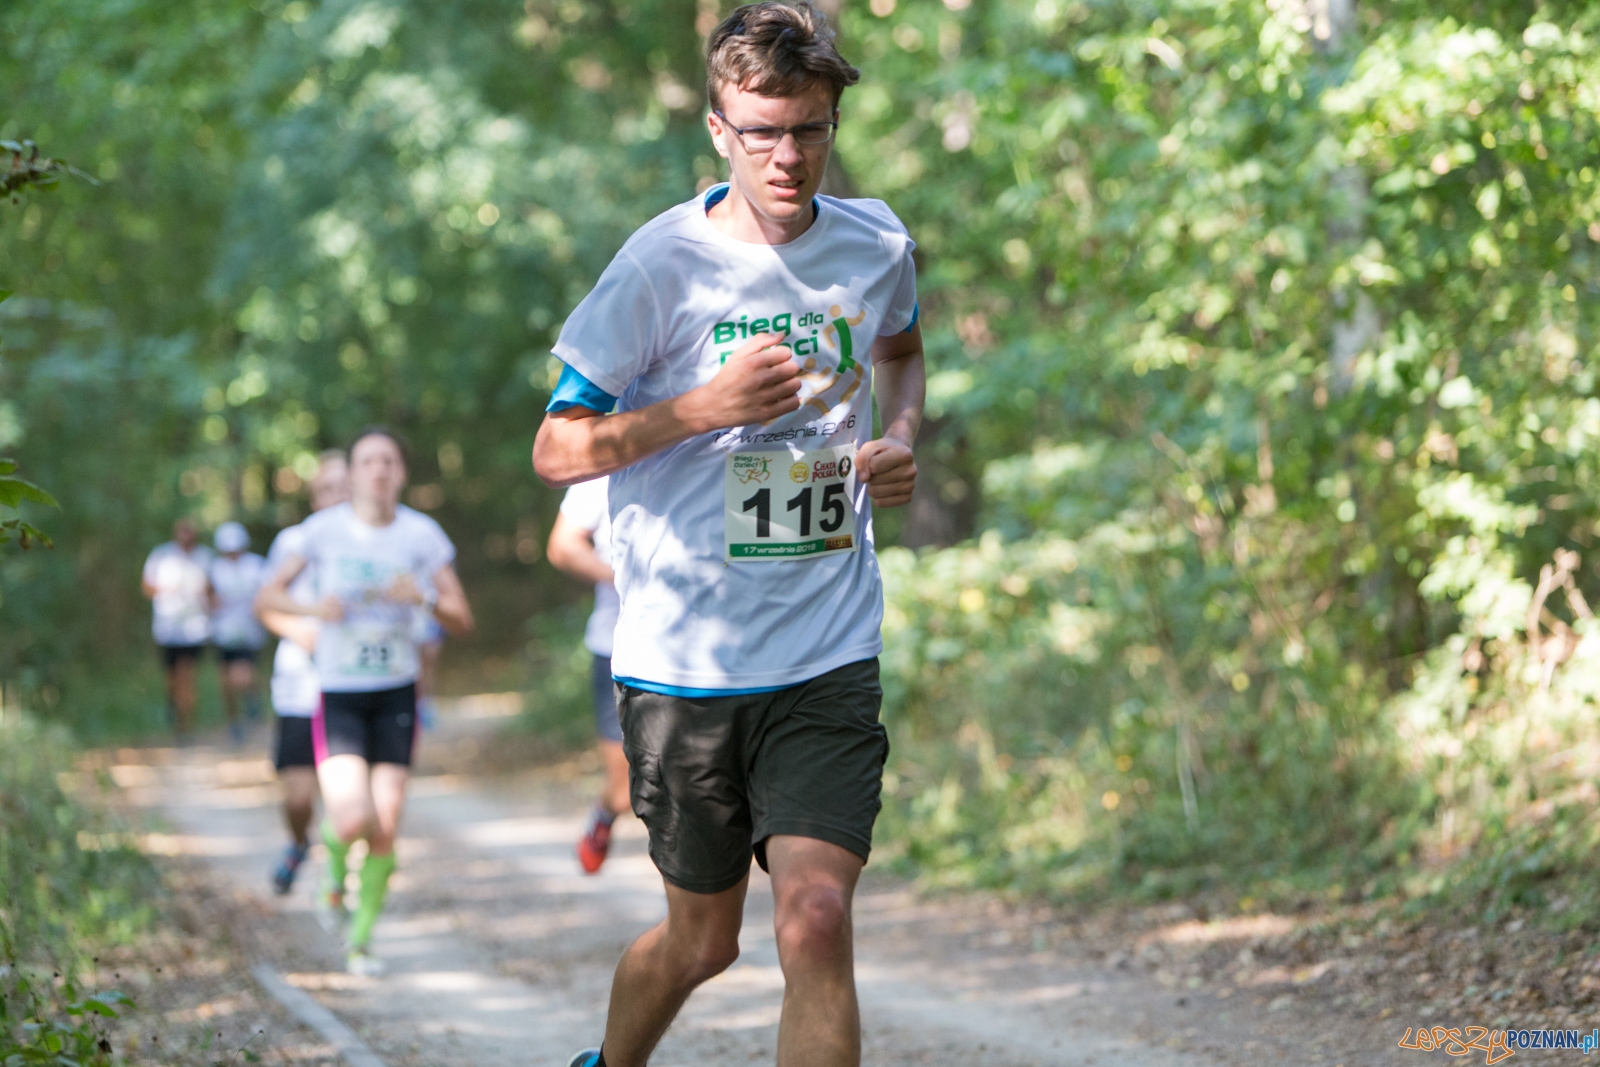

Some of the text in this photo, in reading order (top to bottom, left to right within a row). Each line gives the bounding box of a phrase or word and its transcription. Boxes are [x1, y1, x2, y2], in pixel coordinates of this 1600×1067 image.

[714, 312, 823, 344] Bieg dla
[740, 426, 817, 443] września
[742, 482, 845, 537] 115
[743, 546, 757, 554] 17
